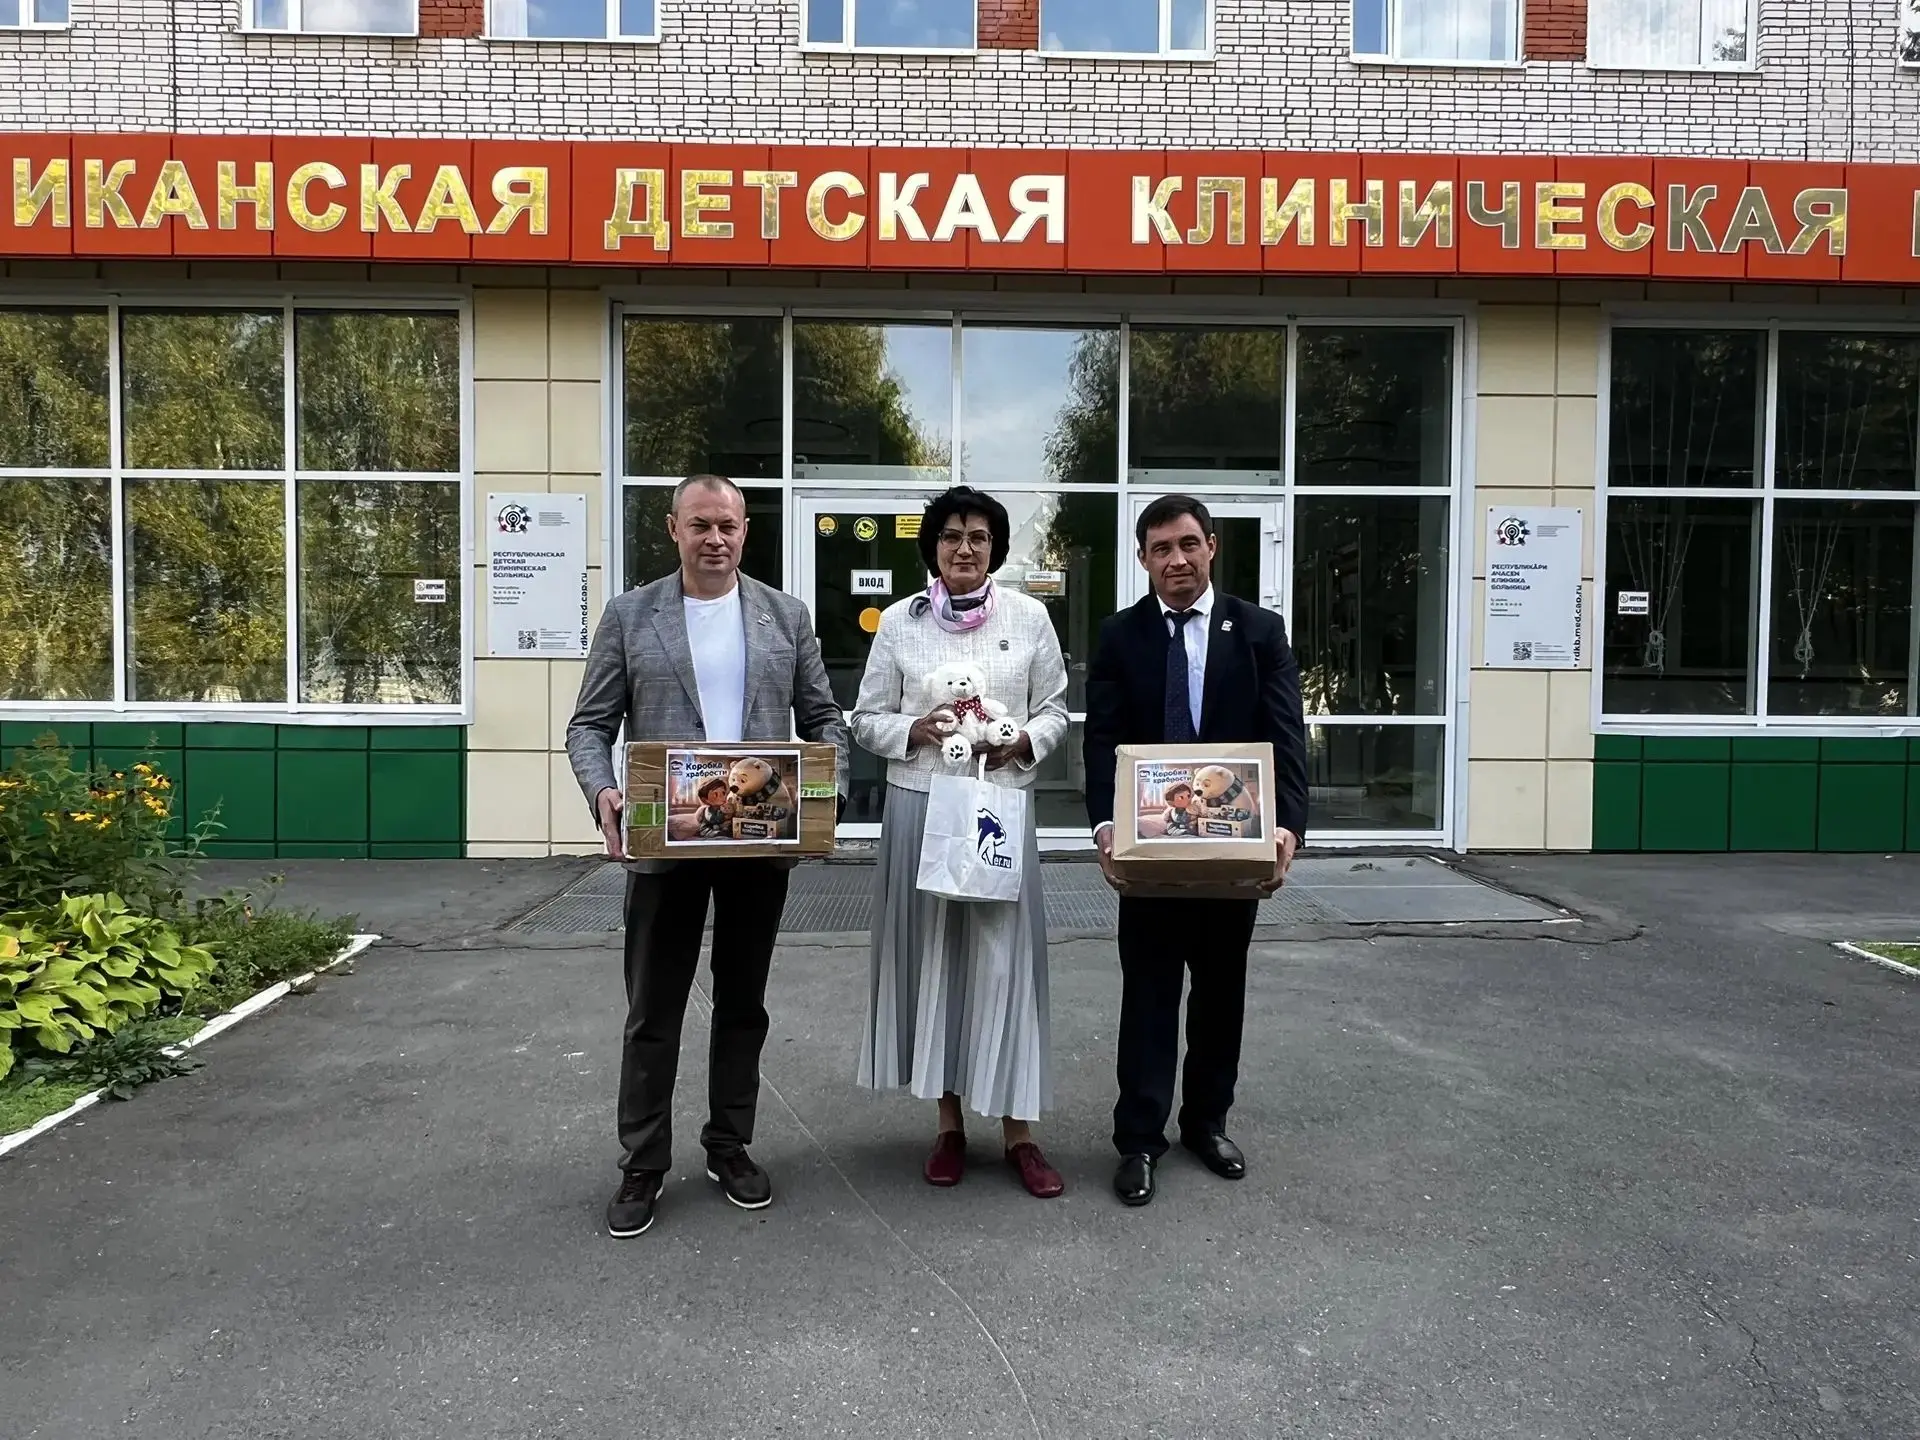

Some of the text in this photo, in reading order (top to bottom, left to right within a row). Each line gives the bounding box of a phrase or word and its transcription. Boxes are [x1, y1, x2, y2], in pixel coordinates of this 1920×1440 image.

[13, 157, 548, 235] ИКАНСКАЯ
[604, 167, 1065, 251] ДЕТСКАЯ
[1131, 175, 1848, 256] КЛИНИЧЕСКАЯ
[858, 577, 884, 589] ВХОД
[686, 762, 723, 771] Коробка
[686, 769, 728, 778] храбрости
[1152, 769, 1188, 777] Коробка
[994, 856, 1011, 868] er.ru
